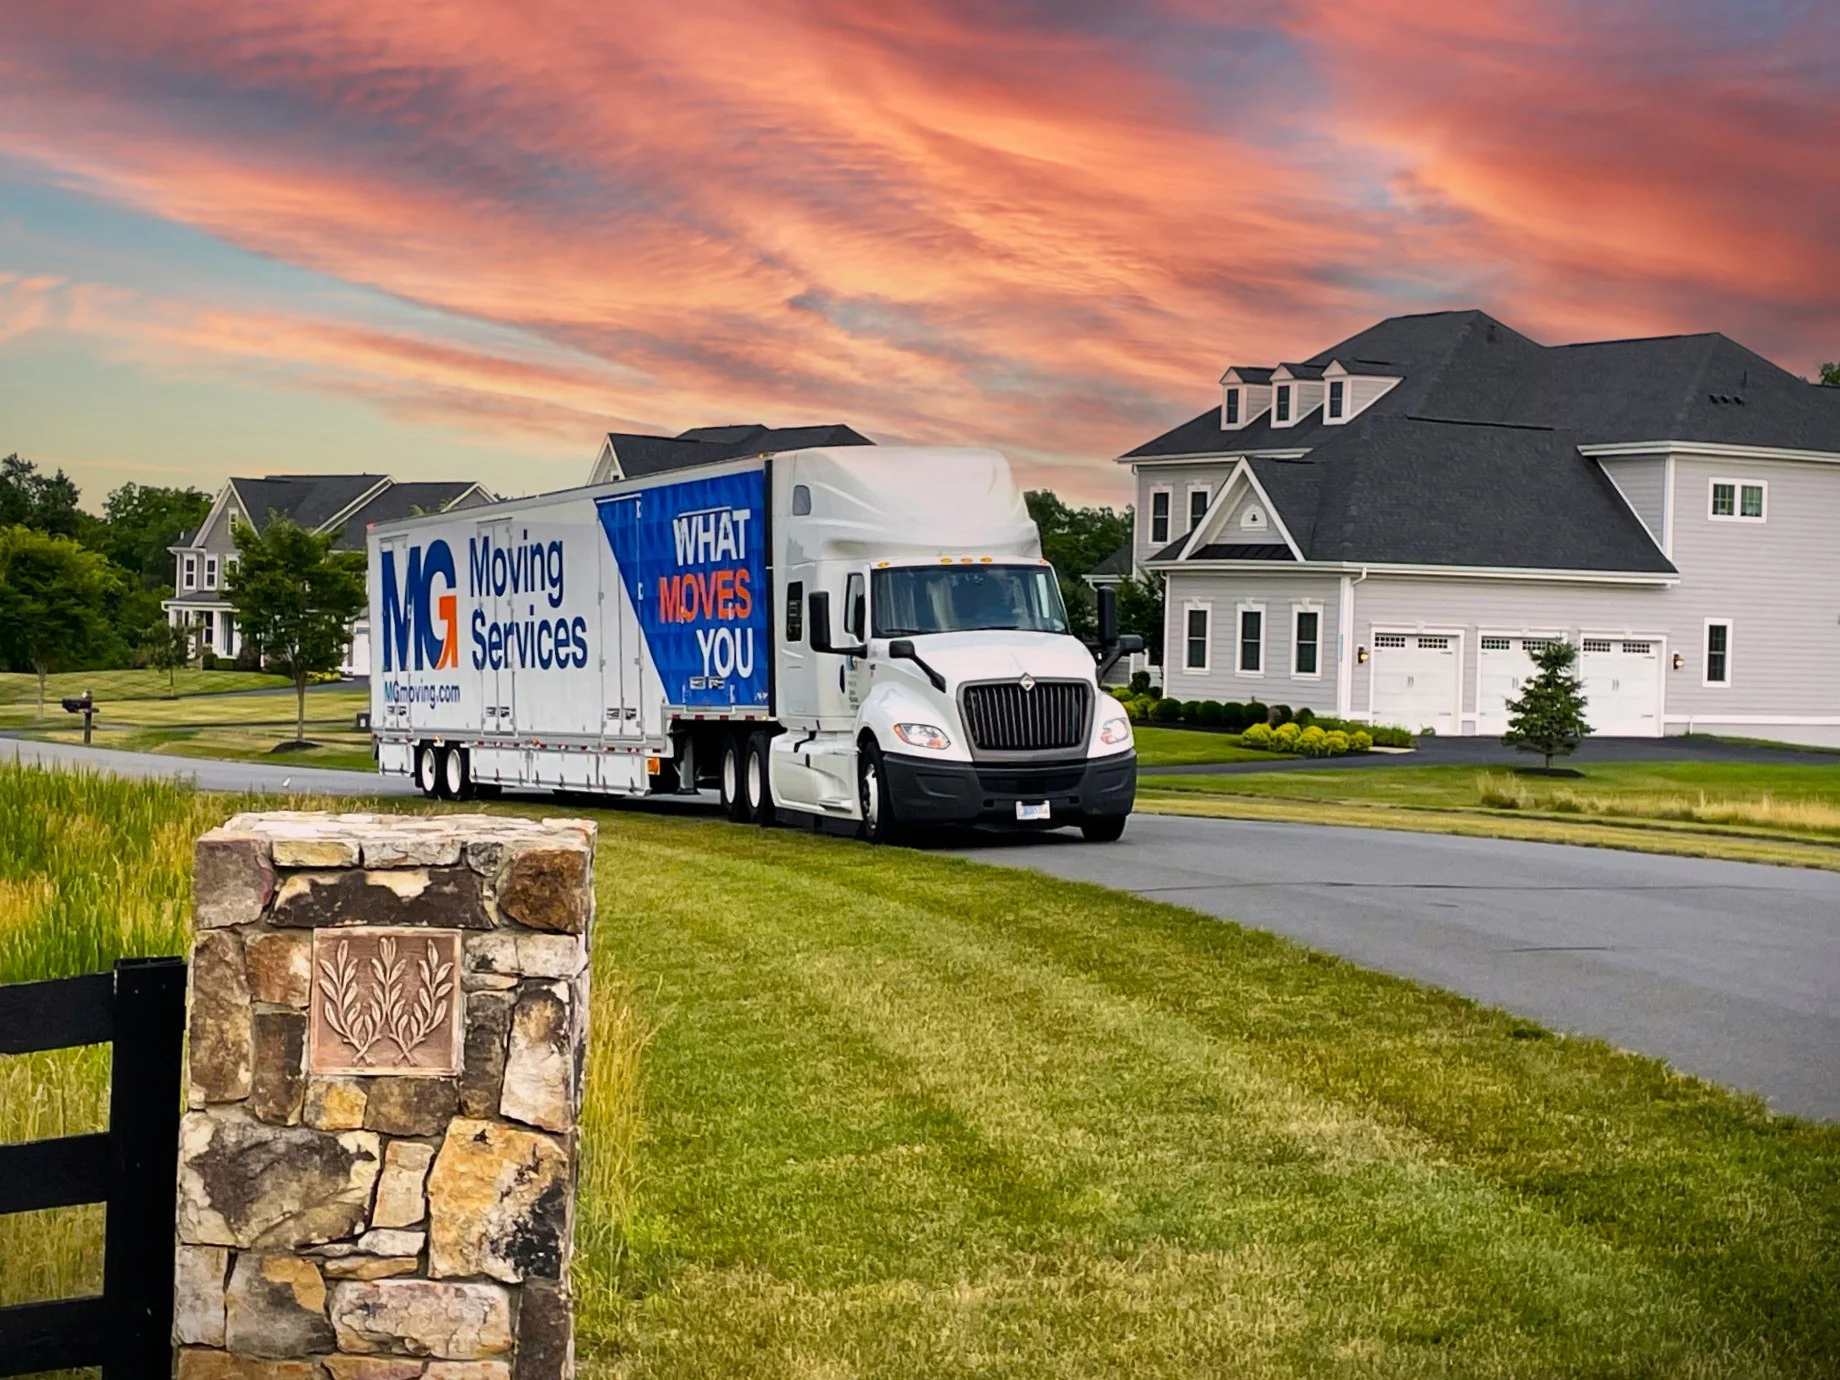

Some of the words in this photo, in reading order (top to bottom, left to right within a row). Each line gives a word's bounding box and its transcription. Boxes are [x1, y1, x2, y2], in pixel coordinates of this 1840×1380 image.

[672, 508, 751, 566] WHAT
[469, 529, 564, 609] Moving
[659, 568, 753, 624] MOVES
[381, 539, 459, 673] MG
[471, 604, 588, 671] Services
[696, 627, 754, 679] YOU
[384, 678, 461, 709] MGmoving.com
